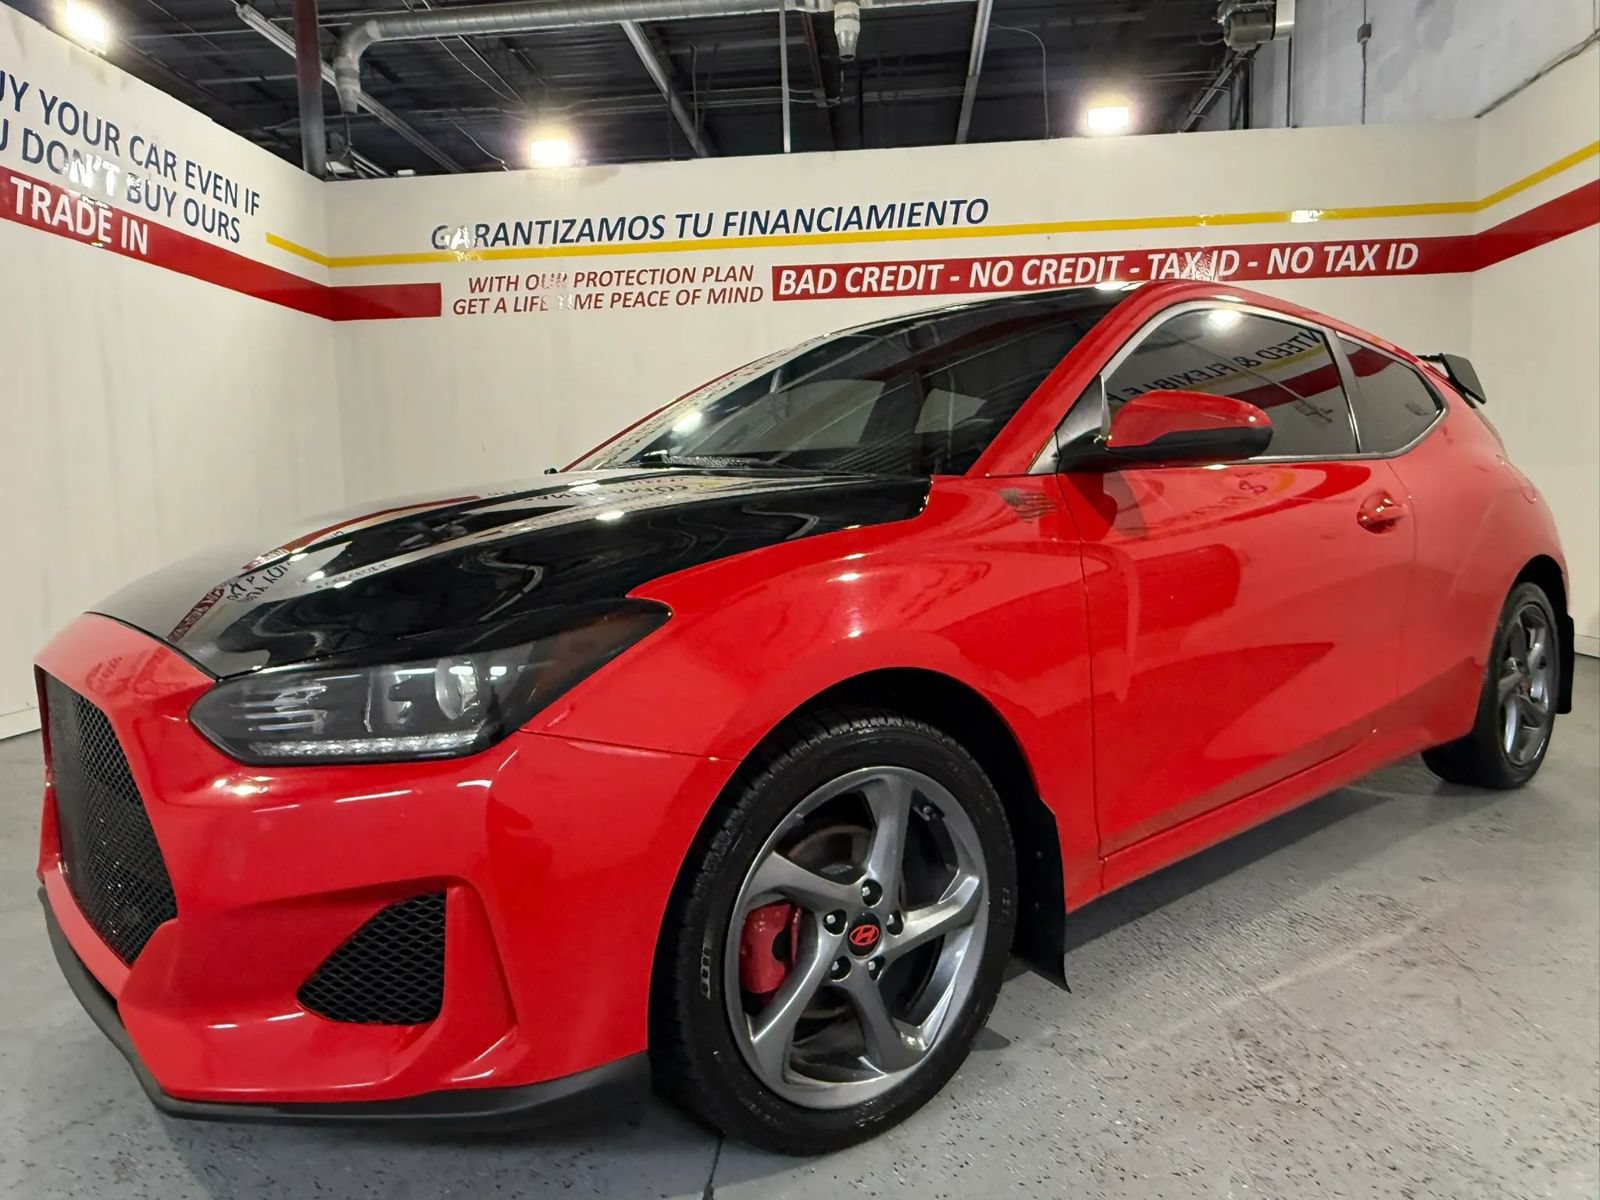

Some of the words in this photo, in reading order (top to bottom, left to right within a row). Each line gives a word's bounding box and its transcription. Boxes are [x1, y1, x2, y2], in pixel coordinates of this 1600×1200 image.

[39, 88, 120, 157] YOUR
[129, 135, 177, 182] CAR
[185, 159, 238, 209] EVEN
[245, 187, 260, 216] IF
[22, 127, 120, 197] DON'T
[126, 171, 177, 218] BUY
[183, 197, 240, 243] OURS
[10, 176, 113, 244] TRADE
[121, 216, 148, 255] IN
[431, 213, 665, 250] GARANTIZAMOS
[675, 212, 714, 238] TU
[723, 198, 989, 237] FINANCIAMIENTO
[468, 274, 519, 294] WITH
[525, 272, 568, 291] OUR
[573, 267, 696, 288] PROTECTION
[702, 265, 754, 284] PLAN
[778, 268, 837, 296] BAD
[845, 263, 944, 293] CREDIT
[969, 260, 1014, 288] NO
[1021, 255, 1124, 286] CREDIT
[1147, 251, 1204, 280] TAX
[1209, 249, 1240, 278] ID
[1266, 247, 1314, 275] NO
[1323, 243, 1381, 272] TAX
[1385, 243, 1419, 270] ID
[453, 298, 490, 315] GET
[494, 297, 507, 313] A
[610, 291, 672, 309] PEACE
[675, 289, 702, 306] OF
[706, 286, 764, 305] MIND
